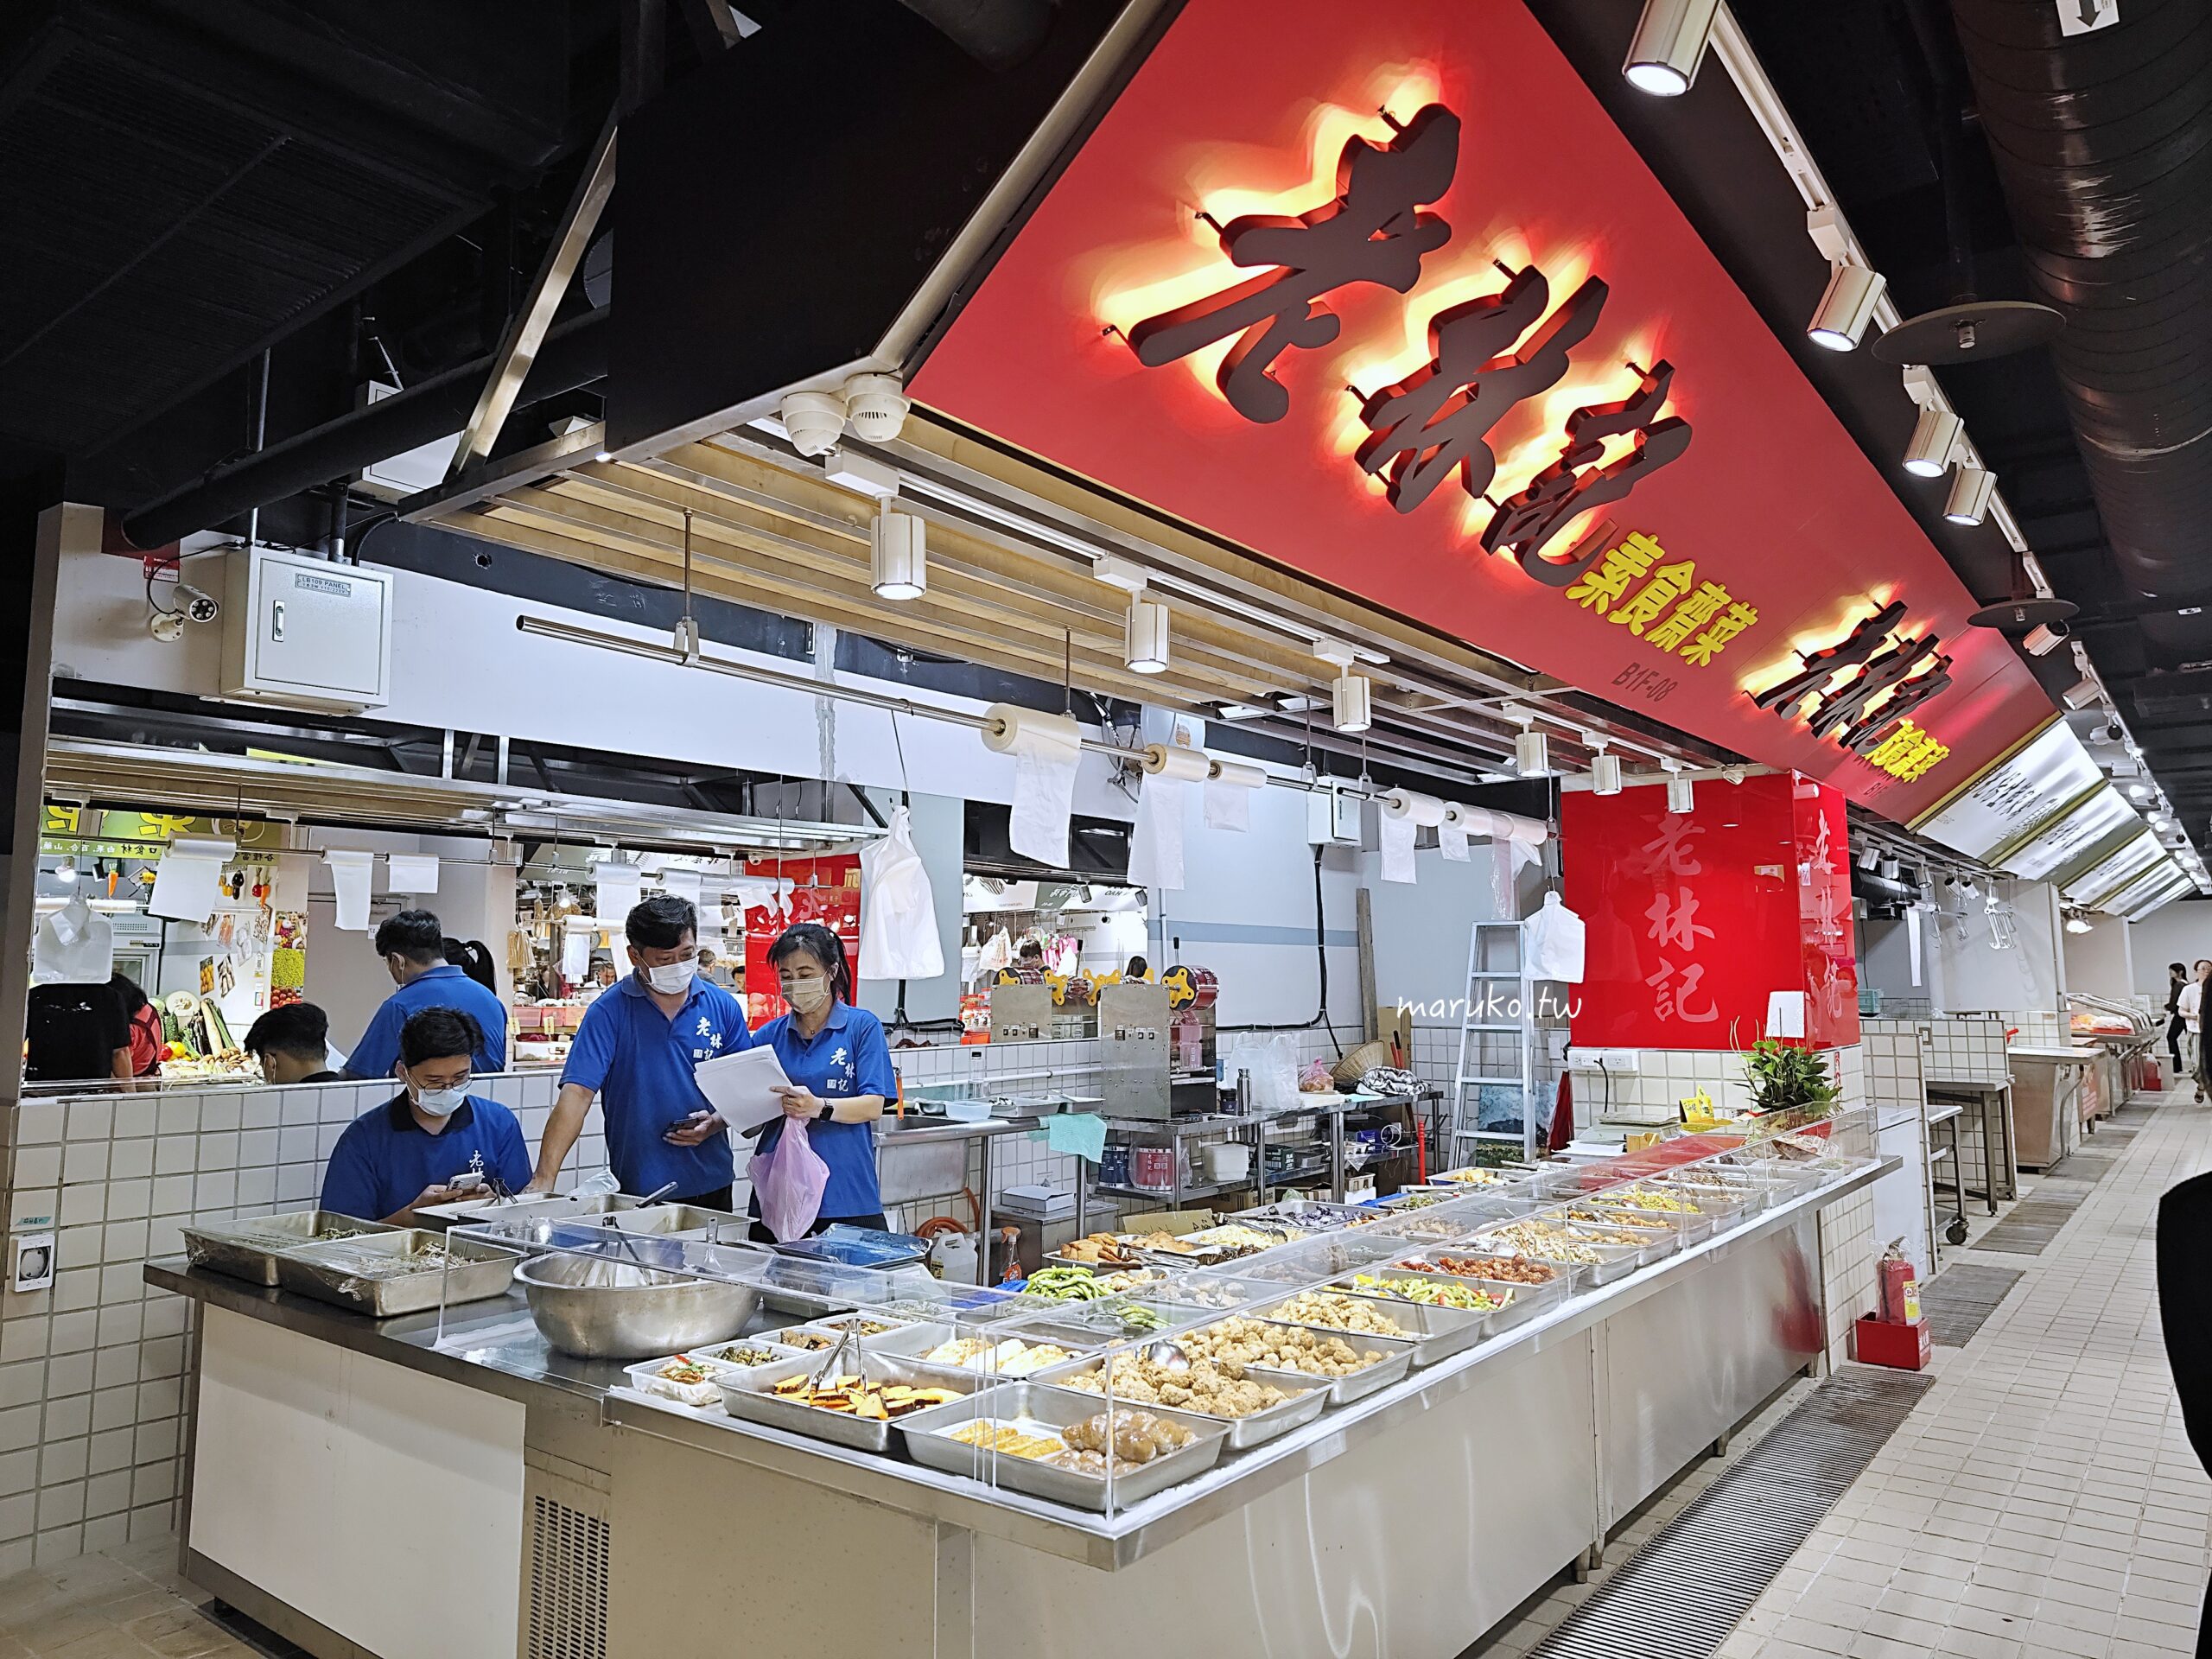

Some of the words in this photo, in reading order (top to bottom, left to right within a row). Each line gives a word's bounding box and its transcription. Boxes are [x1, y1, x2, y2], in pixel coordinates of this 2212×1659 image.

[324, 581, 346, 590] PANEL
[1564, 530, 1759, 668] 素食齋菜
[1611, 662, 1678, 702] B1F-08
[1639, 812, 1719, 1023] 老林記
[694, 1017, 723, 1060] 老林記
[830, 1047, 856, 1092] 老林記
